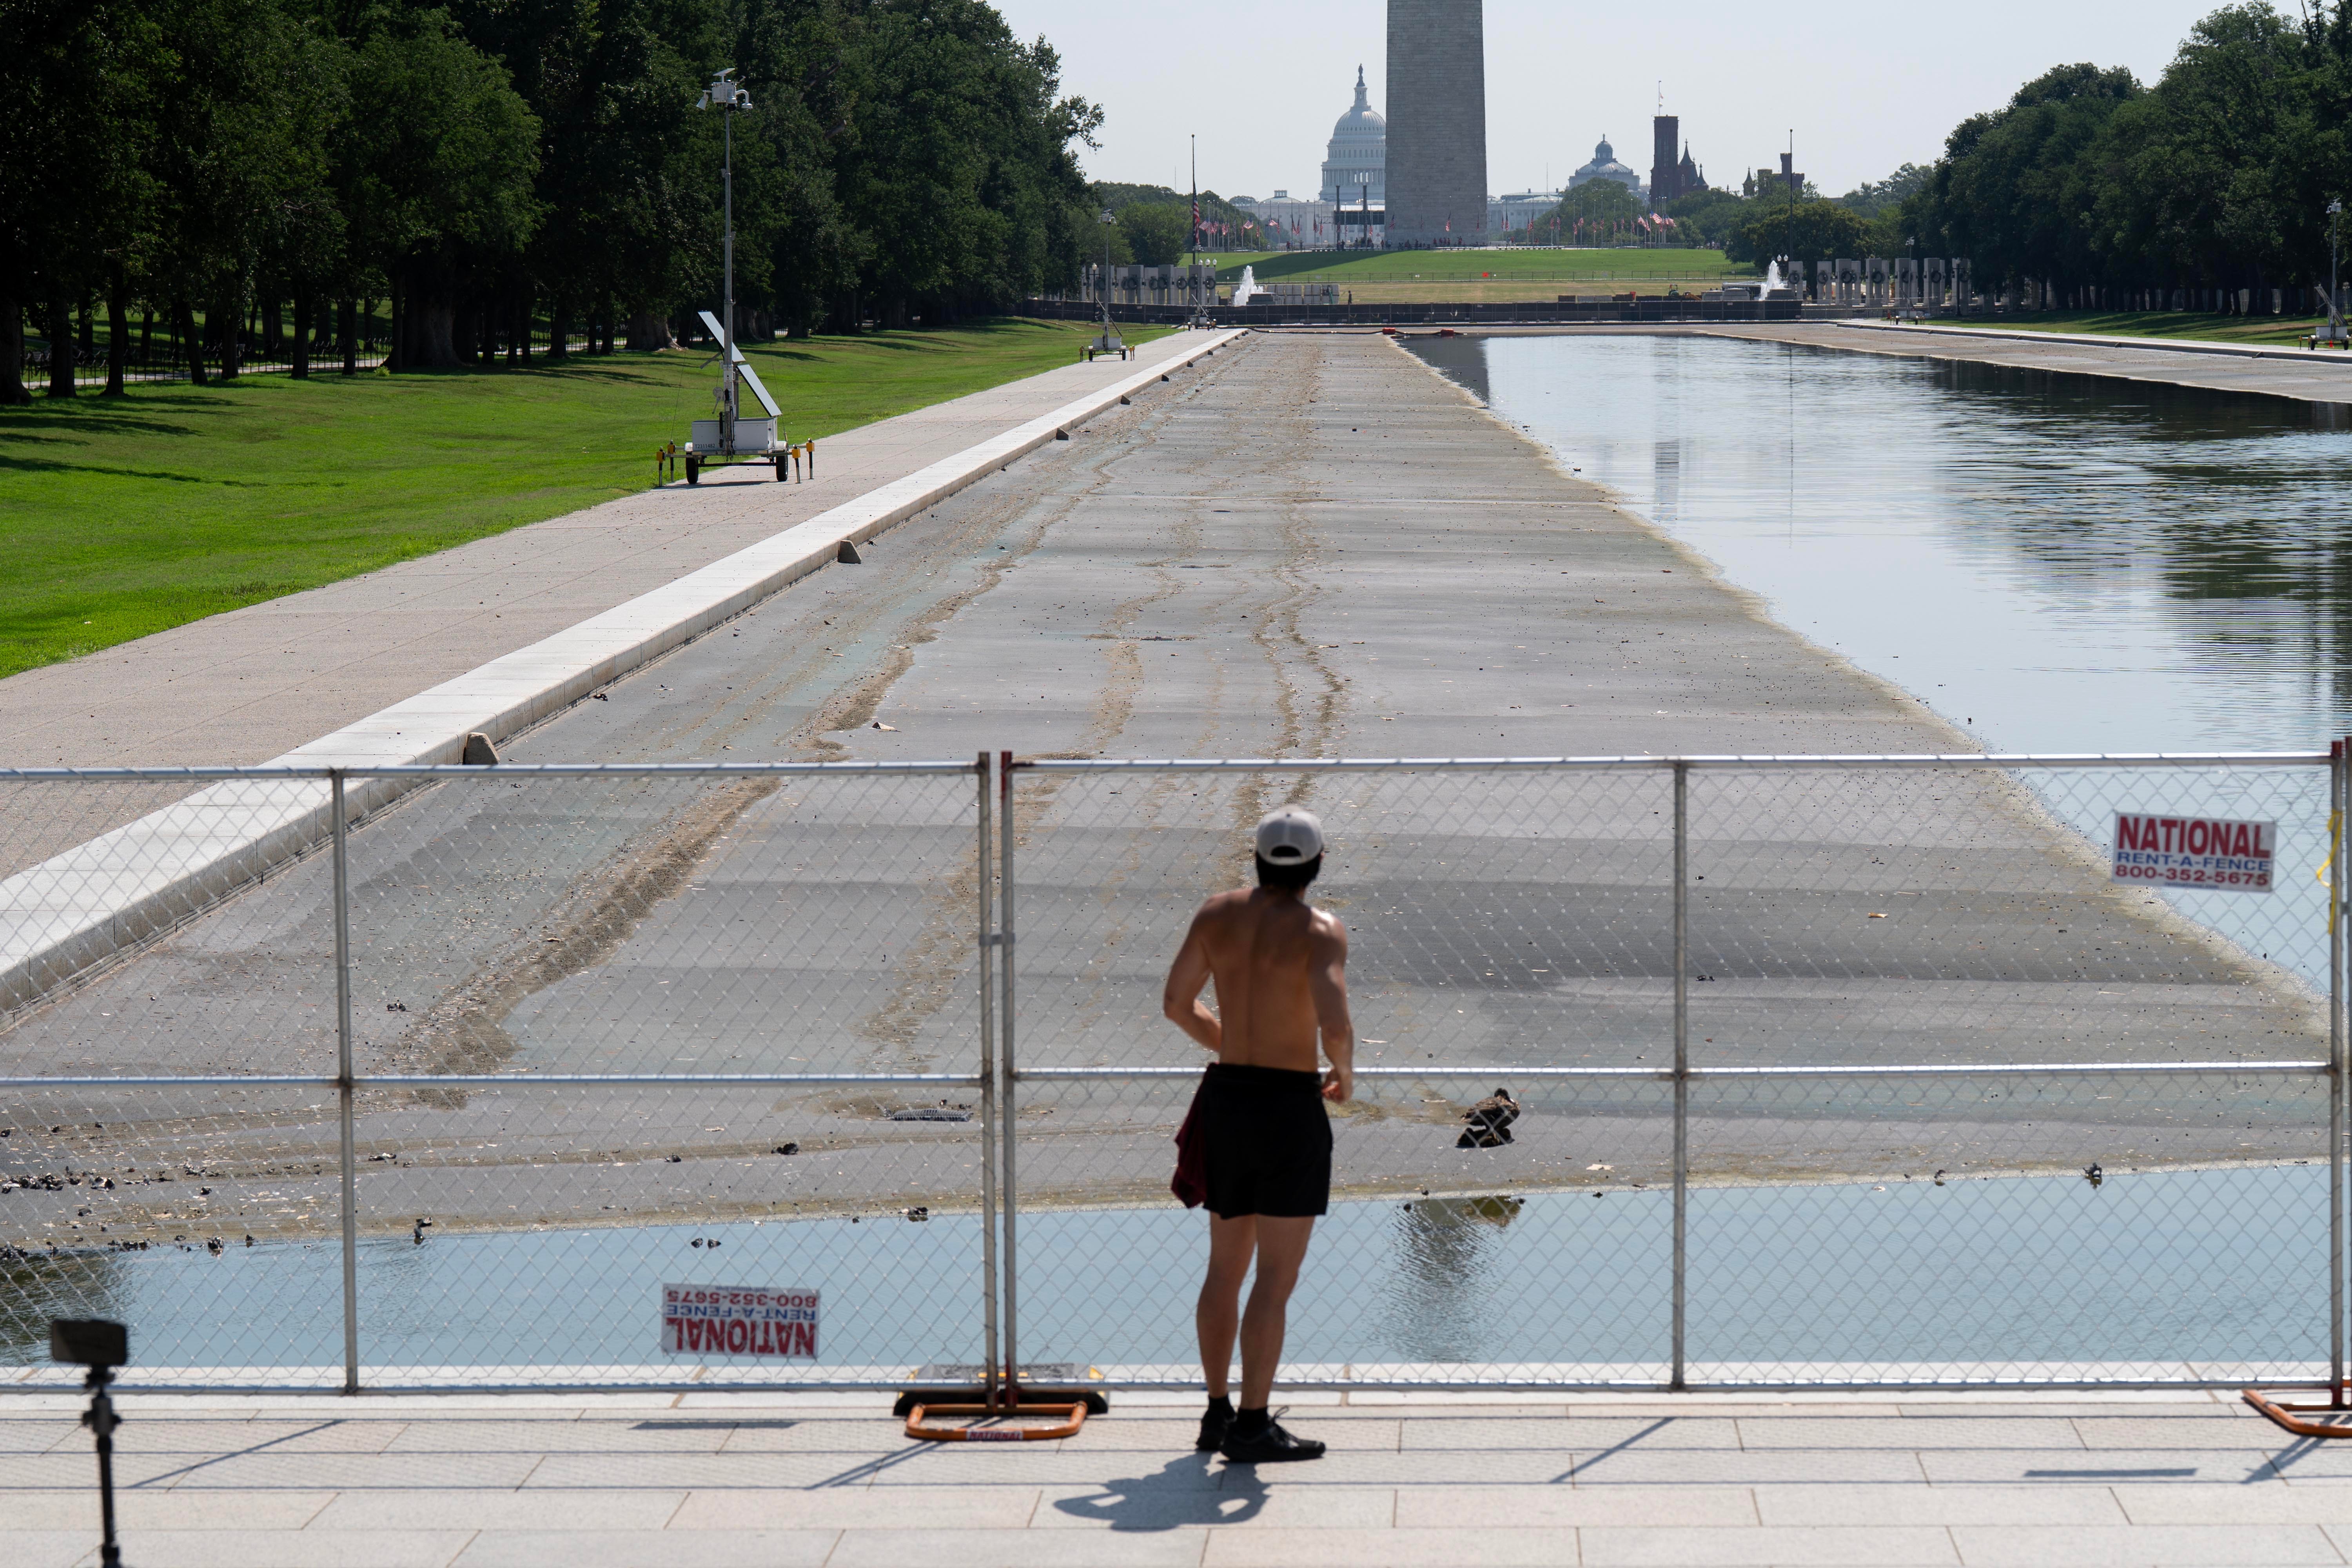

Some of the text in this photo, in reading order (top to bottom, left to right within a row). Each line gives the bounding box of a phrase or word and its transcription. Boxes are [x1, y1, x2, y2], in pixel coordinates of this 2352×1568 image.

[2118, 816, 2271, 858] NATIONAL
[2117, 851, 2269, 871] RENT-A-FENCE
[2115, 864, 2269, 886] 800-352-5675
[667, 1290, 817, 1308] 800-352-5675
[667, 1305, 816, 1320] RENT-A-FENCE
[666, 1317, 815, 1355] NATIONAL
